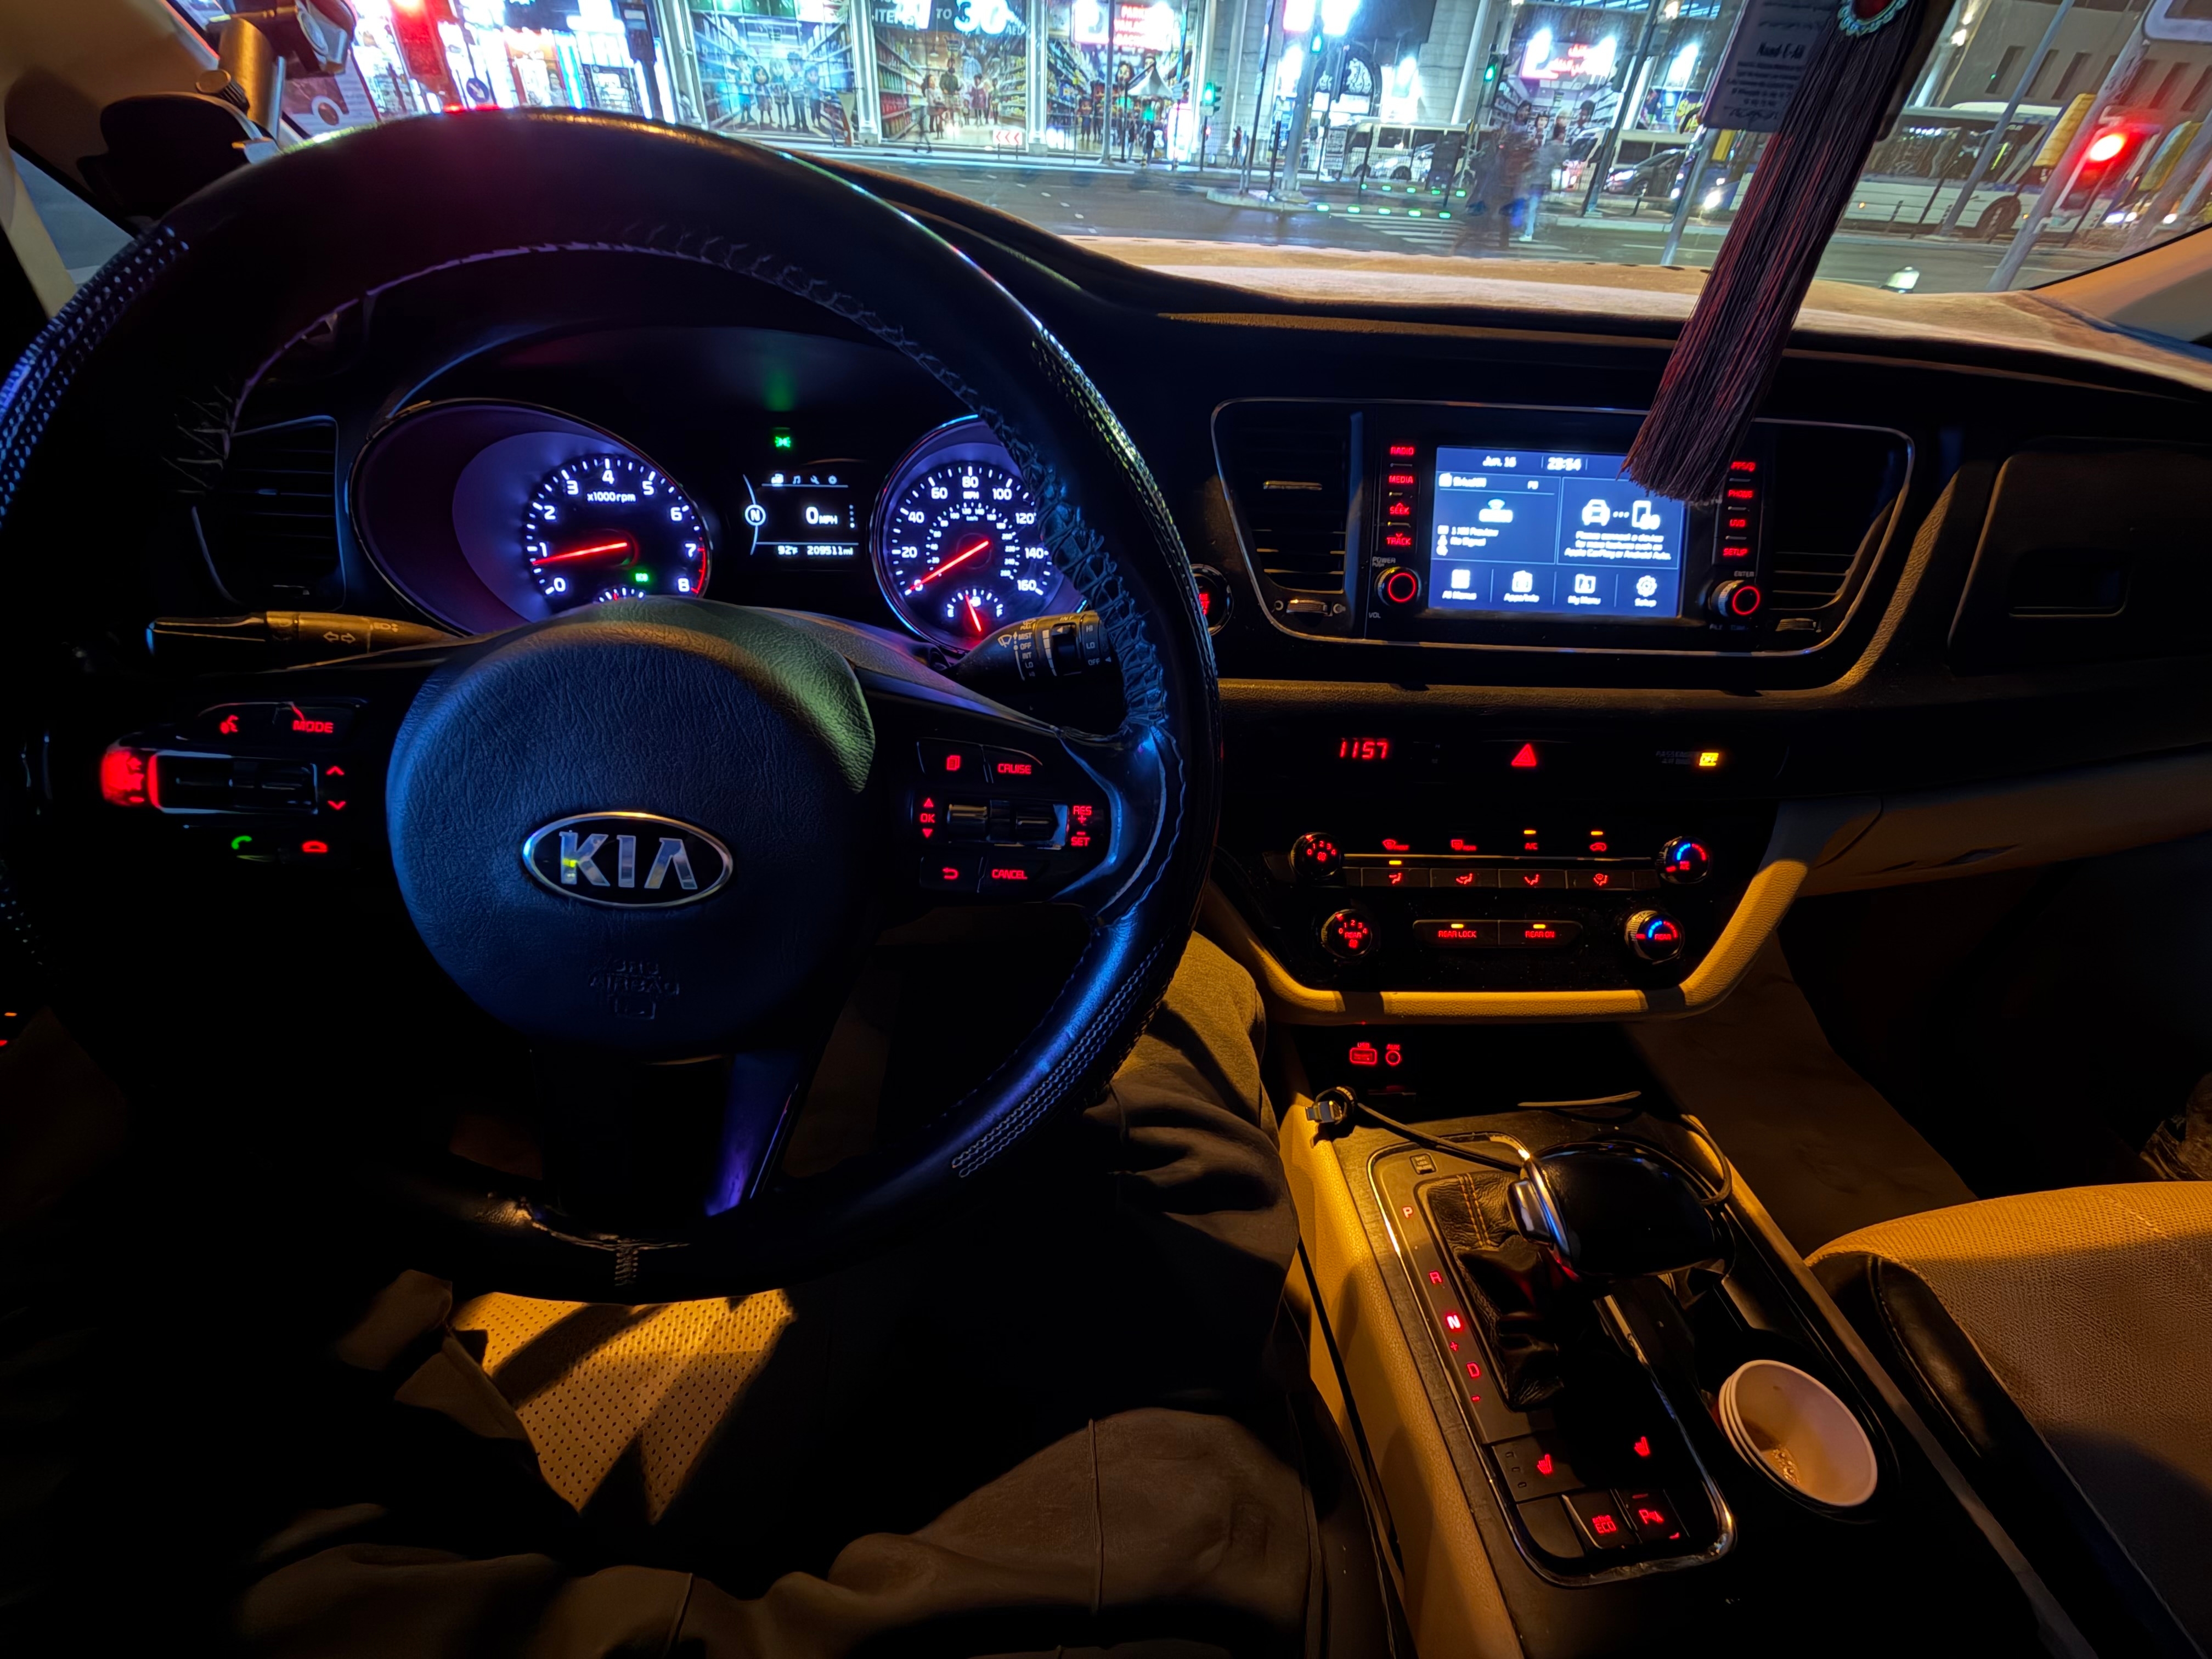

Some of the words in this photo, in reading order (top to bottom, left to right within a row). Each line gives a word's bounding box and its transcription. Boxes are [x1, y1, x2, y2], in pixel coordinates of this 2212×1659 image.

[936, 8, 952, 19] TO
[1390, 447, 1414, 456] RADIO
[602, 470, 614, 484] 4
[962, 476, 979, 488] 80
[1389, 475, 1414, 484] MEDIA
[567, 480, 579, 495] 3
[642, 481, 654, 495] 5
[931, 487, 948, 499] 60
[1728, 489, 1753, 498] PHONE
[992, 488, 1012, 500] 100
[544, 505, 556, 520] 2
[670, 507, 682, 521] 6
[751, 509, 760, 521] N
[806, 506, 819, 524] 0
[1390, 506, 1410, 515] SEEK
[908, 511, 924, 523] 40
[1015, 513, 1035, 524] 120
[1387, 537, 1411, 546] TRACK
[1576, 531, 1600, 540] Please
[1638, 534, 1664, 543] device
[539, 542, 548, 557] 1
[685, 543, 696, 557] 7
[901, 546, 917, 558] 20
[1025, 548, 1044, 559] 140
[1564, 548, 1587, 557] Apple
[1723, 548, 1748, 556] SETUP
[554, 577, 566, 592] 0
[678, 578, 690, 592] 8
[1017, 580, 1037, 591] 160
[1018, 632, 1032, 640] MIST
[292, 720, 334, 733] MODE
[997, 763, 1032, 774] CRUISE
[1073, 805, 1092, 816] RES
[920, 814, 935, 823] OK
[1071, 837, 1090, 847] SET
[560, 830, 697, 890] KIA
[992, 869, 1028, 880] CANCEL
[1402, 1206, 1413, 1218] P
[1429, 1271, 1443, 1284] R
[1447, 1315, 1461, 1329] N
[1466, 1363, 1481, 1378] D
[1595, 1521, 1616, 1534] ECO
